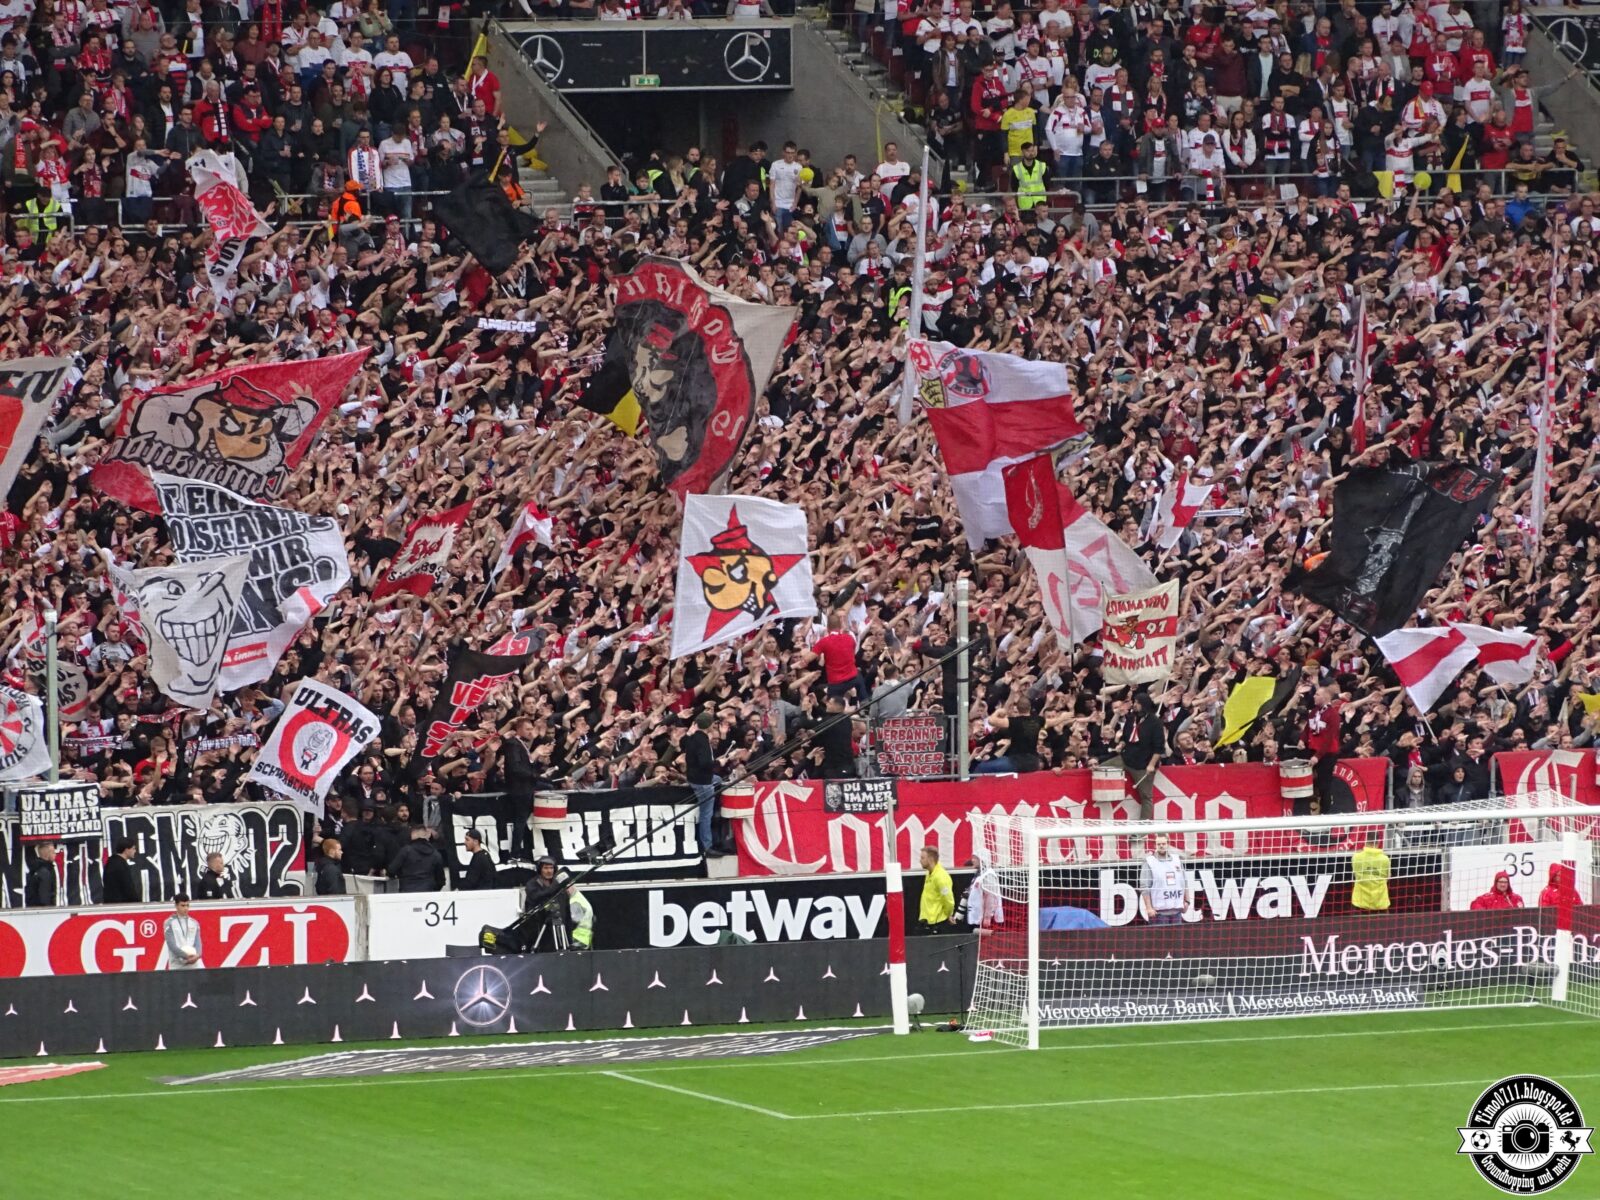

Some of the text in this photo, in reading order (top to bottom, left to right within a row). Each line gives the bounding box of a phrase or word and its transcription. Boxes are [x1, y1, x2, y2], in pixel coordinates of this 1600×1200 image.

[477, 317, 537, 333] AMIGOS
[1103, 645, 1169, 671] CANNSTATT
[294, 687, 374, 744] ULTRAS
[883, 717, 936, 728] JEDER
[876, 727, 944, 741] VERBANNTE
[843, 781, 892, 792] DU BIST
[20, 789, 99, 812] ULTRAS
[843, 790, 894, 803] IMMER
[21, 806, 99, 825] BEDEUTET
[843, 802, 889, 812] BEI UNS
[21, 819, 101, 835] WIDERSTAND
[738, 768, 1250, 877] Commando
[1503, 852, 1535, 877] 35
[1163, 889, 1183, 900] SMF
[424, 901, 459, 927] 34
[648, 889, 886, 948] betway
[1038, 987, 1420, 1020] Mercedes-Benz Bank Mercedes-Benz Bank
